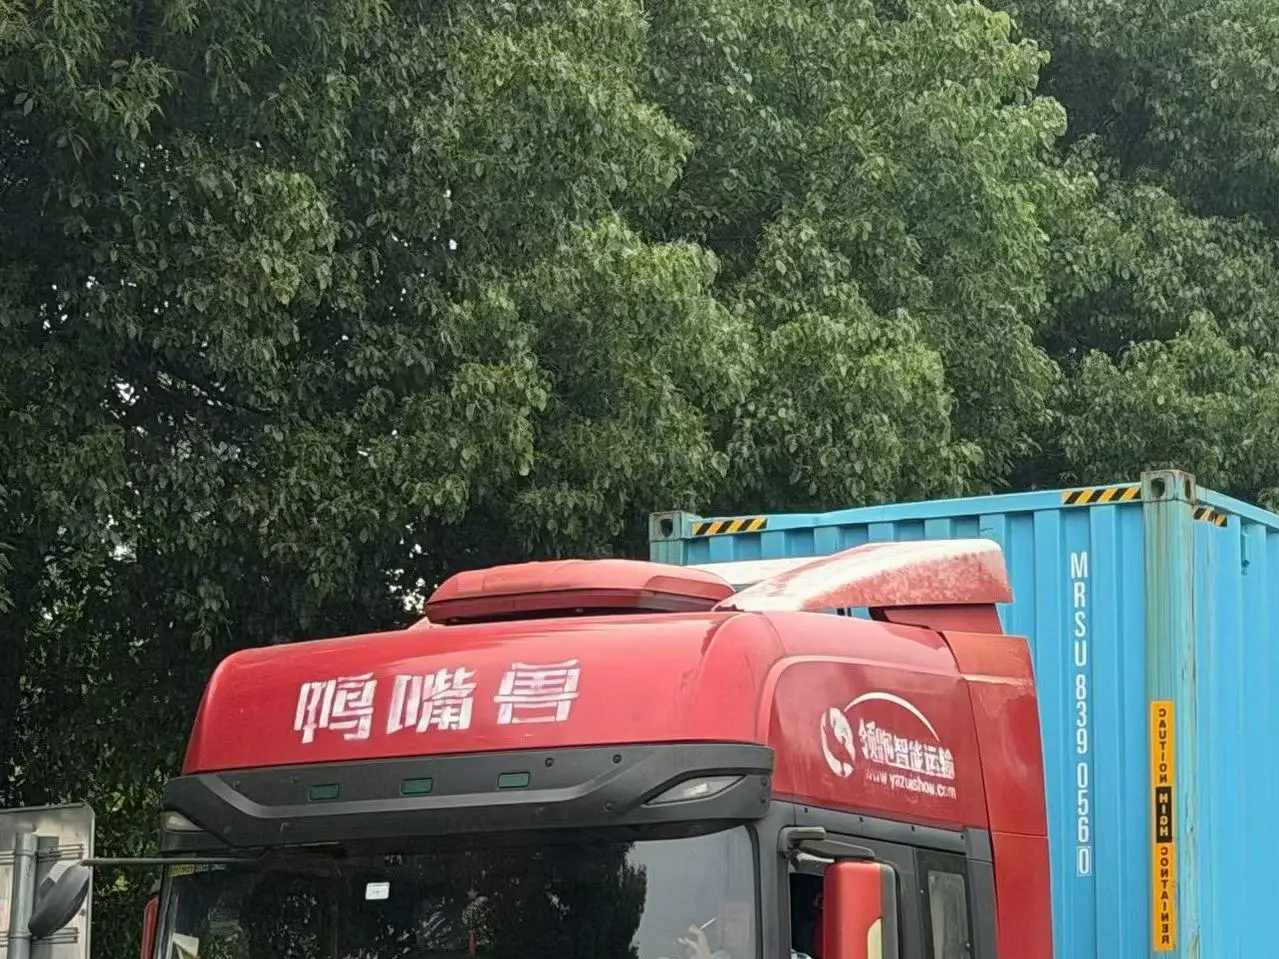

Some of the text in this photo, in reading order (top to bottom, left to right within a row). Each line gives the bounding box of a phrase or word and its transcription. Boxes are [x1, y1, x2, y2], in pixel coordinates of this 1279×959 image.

[1070, 551, 1089, 667] MRSU
[293, 658, 581, 744] 鸭嘴兽
